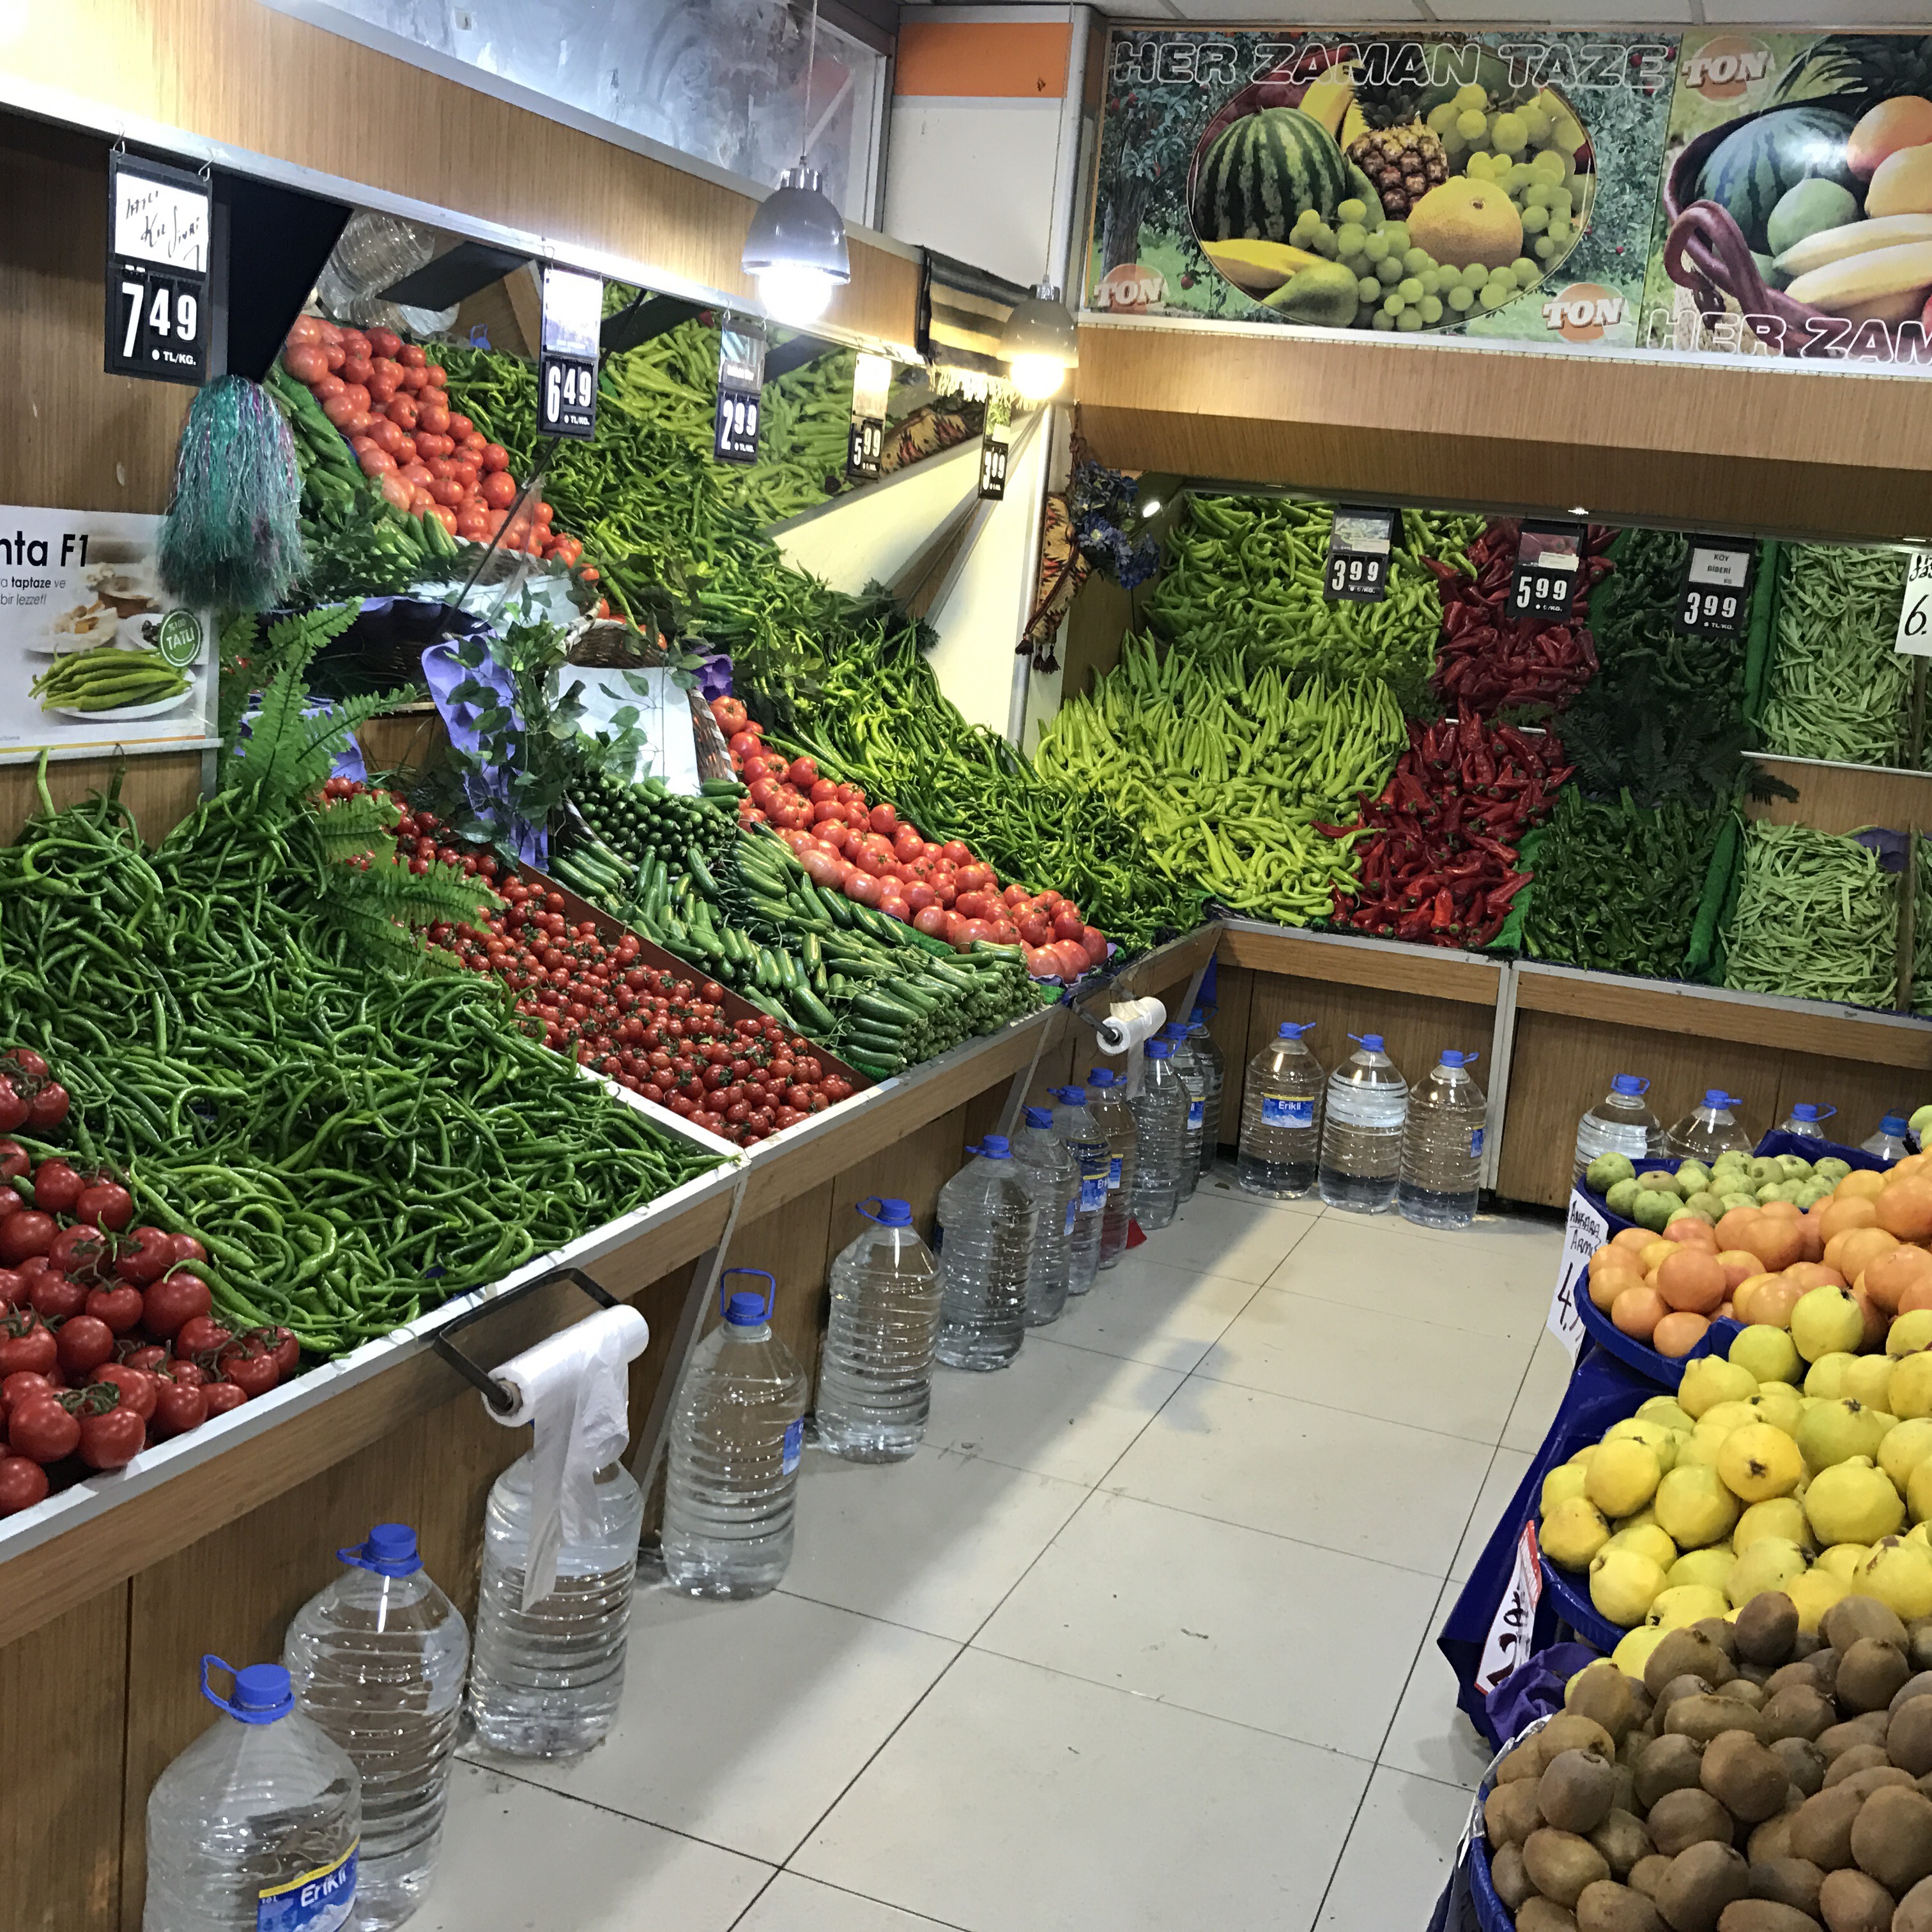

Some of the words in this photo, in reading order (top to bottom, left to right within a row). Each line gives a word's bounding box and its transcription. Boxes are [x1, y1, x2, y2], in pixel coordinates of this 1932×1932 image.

[1114, 42, 1238, 85] HER
[1250, 43, 1481, 87] ZAMAN
[1498, 44, 1668, 89] TAZE
[1682, 50, 1767, 89] TON
[1093, 277, 1163, 307] TON
[1542, 297, 1625, 330] TON
[1646, 309, 1787, 356] HER
[163, 351, 196, 365] TL/KG.
[61, 533, 89, 567] F1
[12, 576, 52, 591] taptaze
[54, 579, 66, 588] ve
[166, 627, 195, 650] TATLI
[1278, 1101, 1301, 1110] Erikli
[300, 1864, 347, 1907] Erikli
